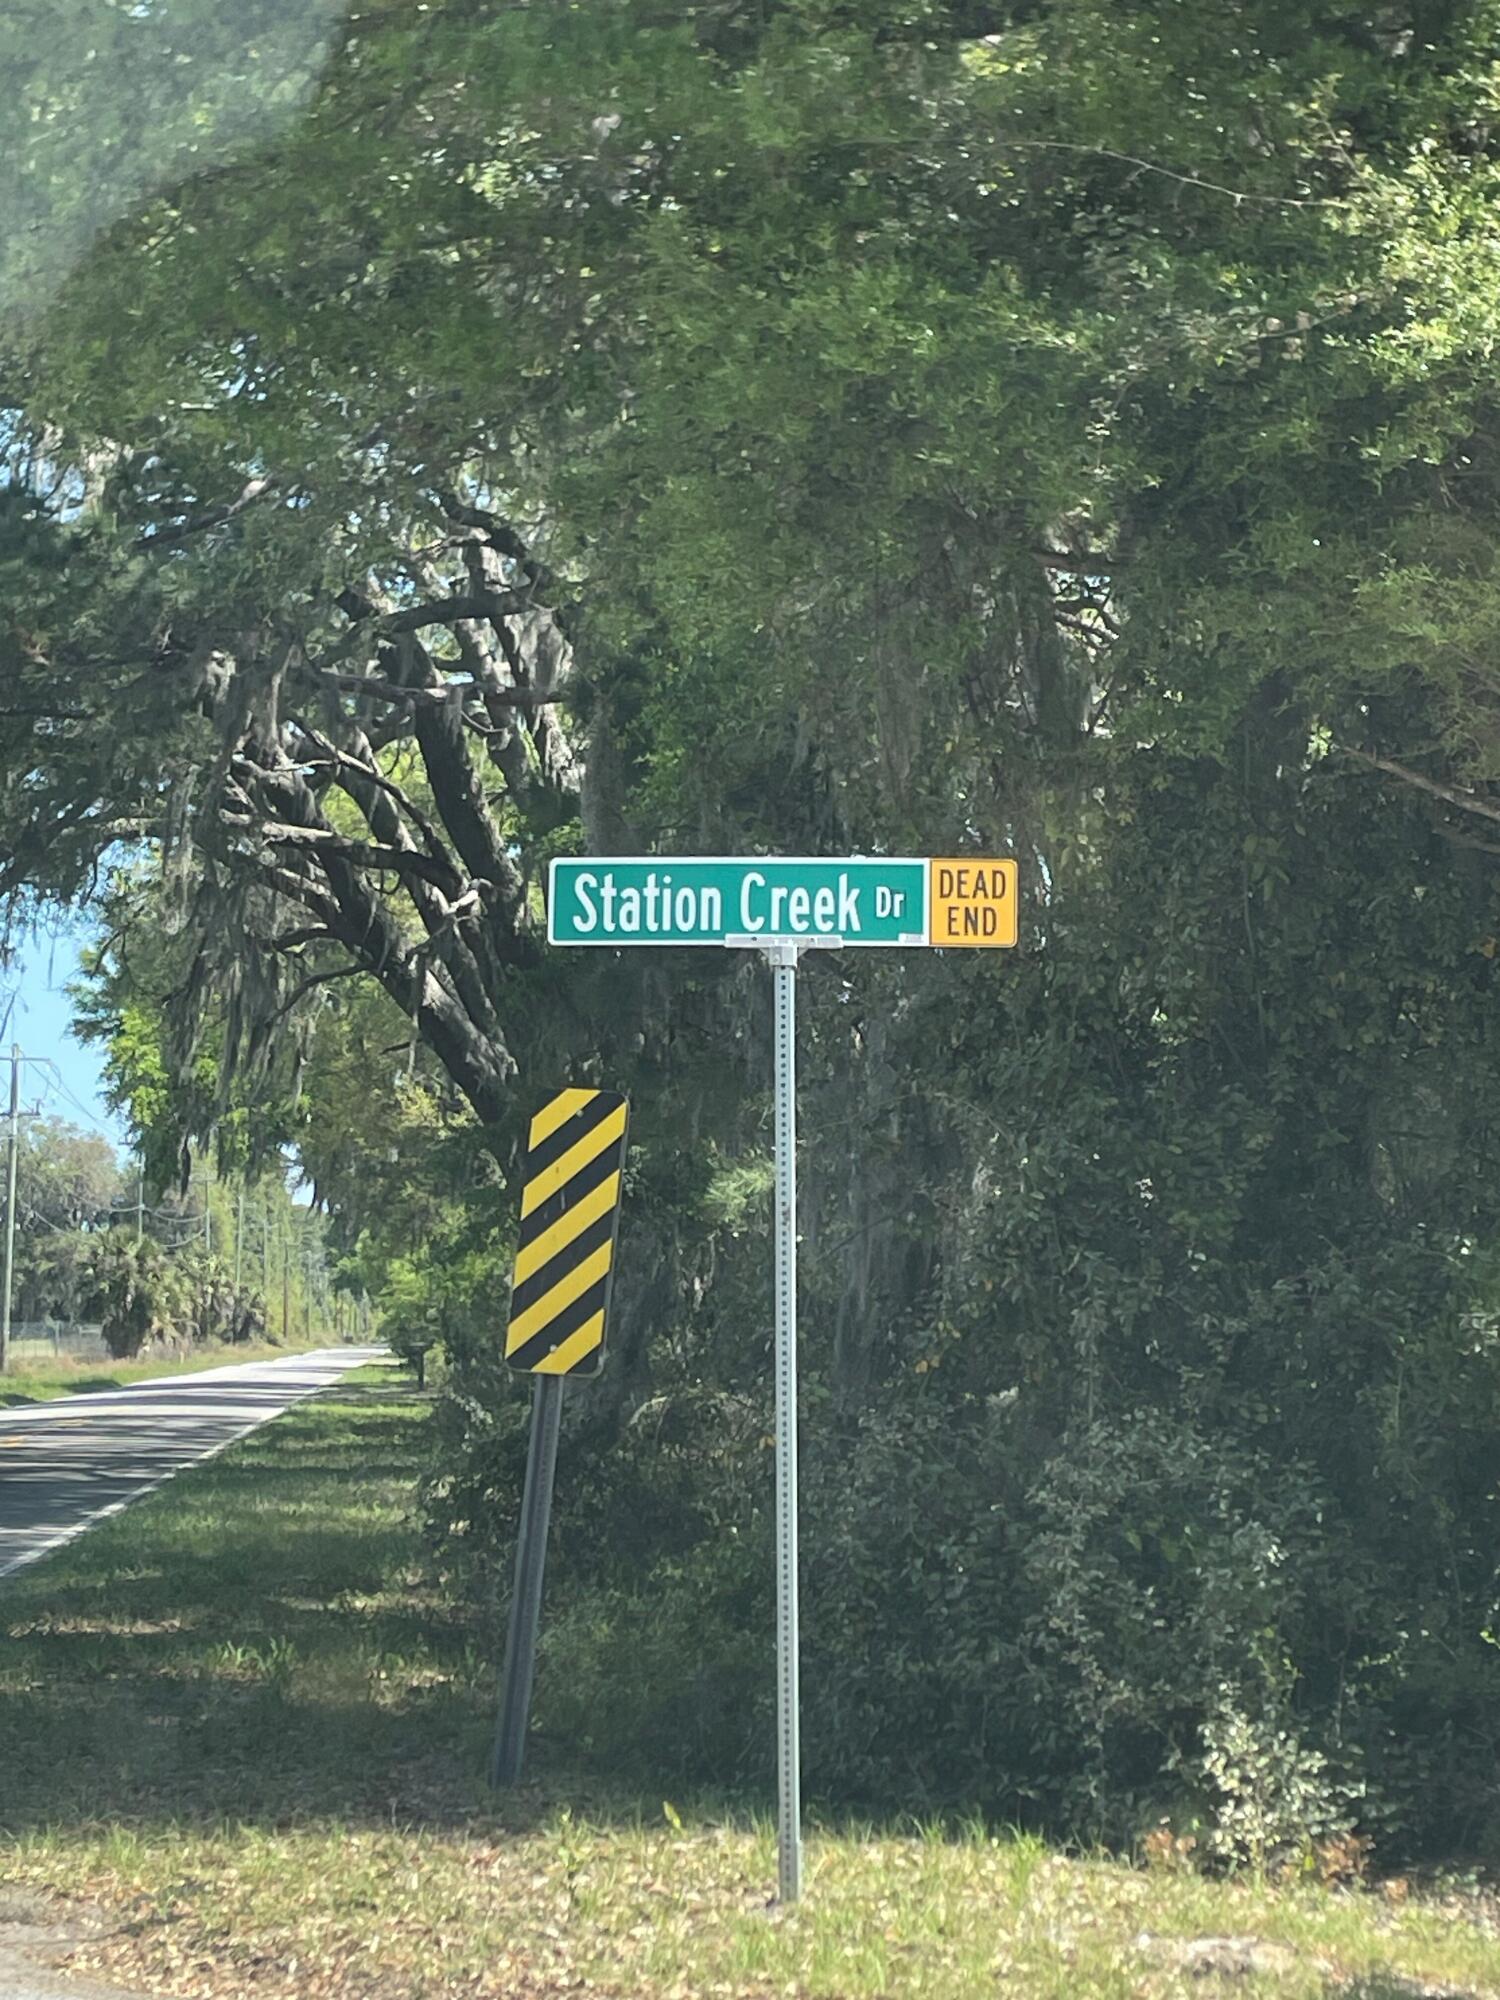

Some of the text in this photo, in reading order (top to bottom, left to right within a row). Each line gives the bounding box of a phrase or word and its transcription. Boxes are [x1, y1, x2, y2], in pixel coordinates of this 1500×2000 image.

[939, 869, 1006, 899] DEAD
[573, 872, 905, 932] Station Creek Dr
[947, 906, 997, 936] END
